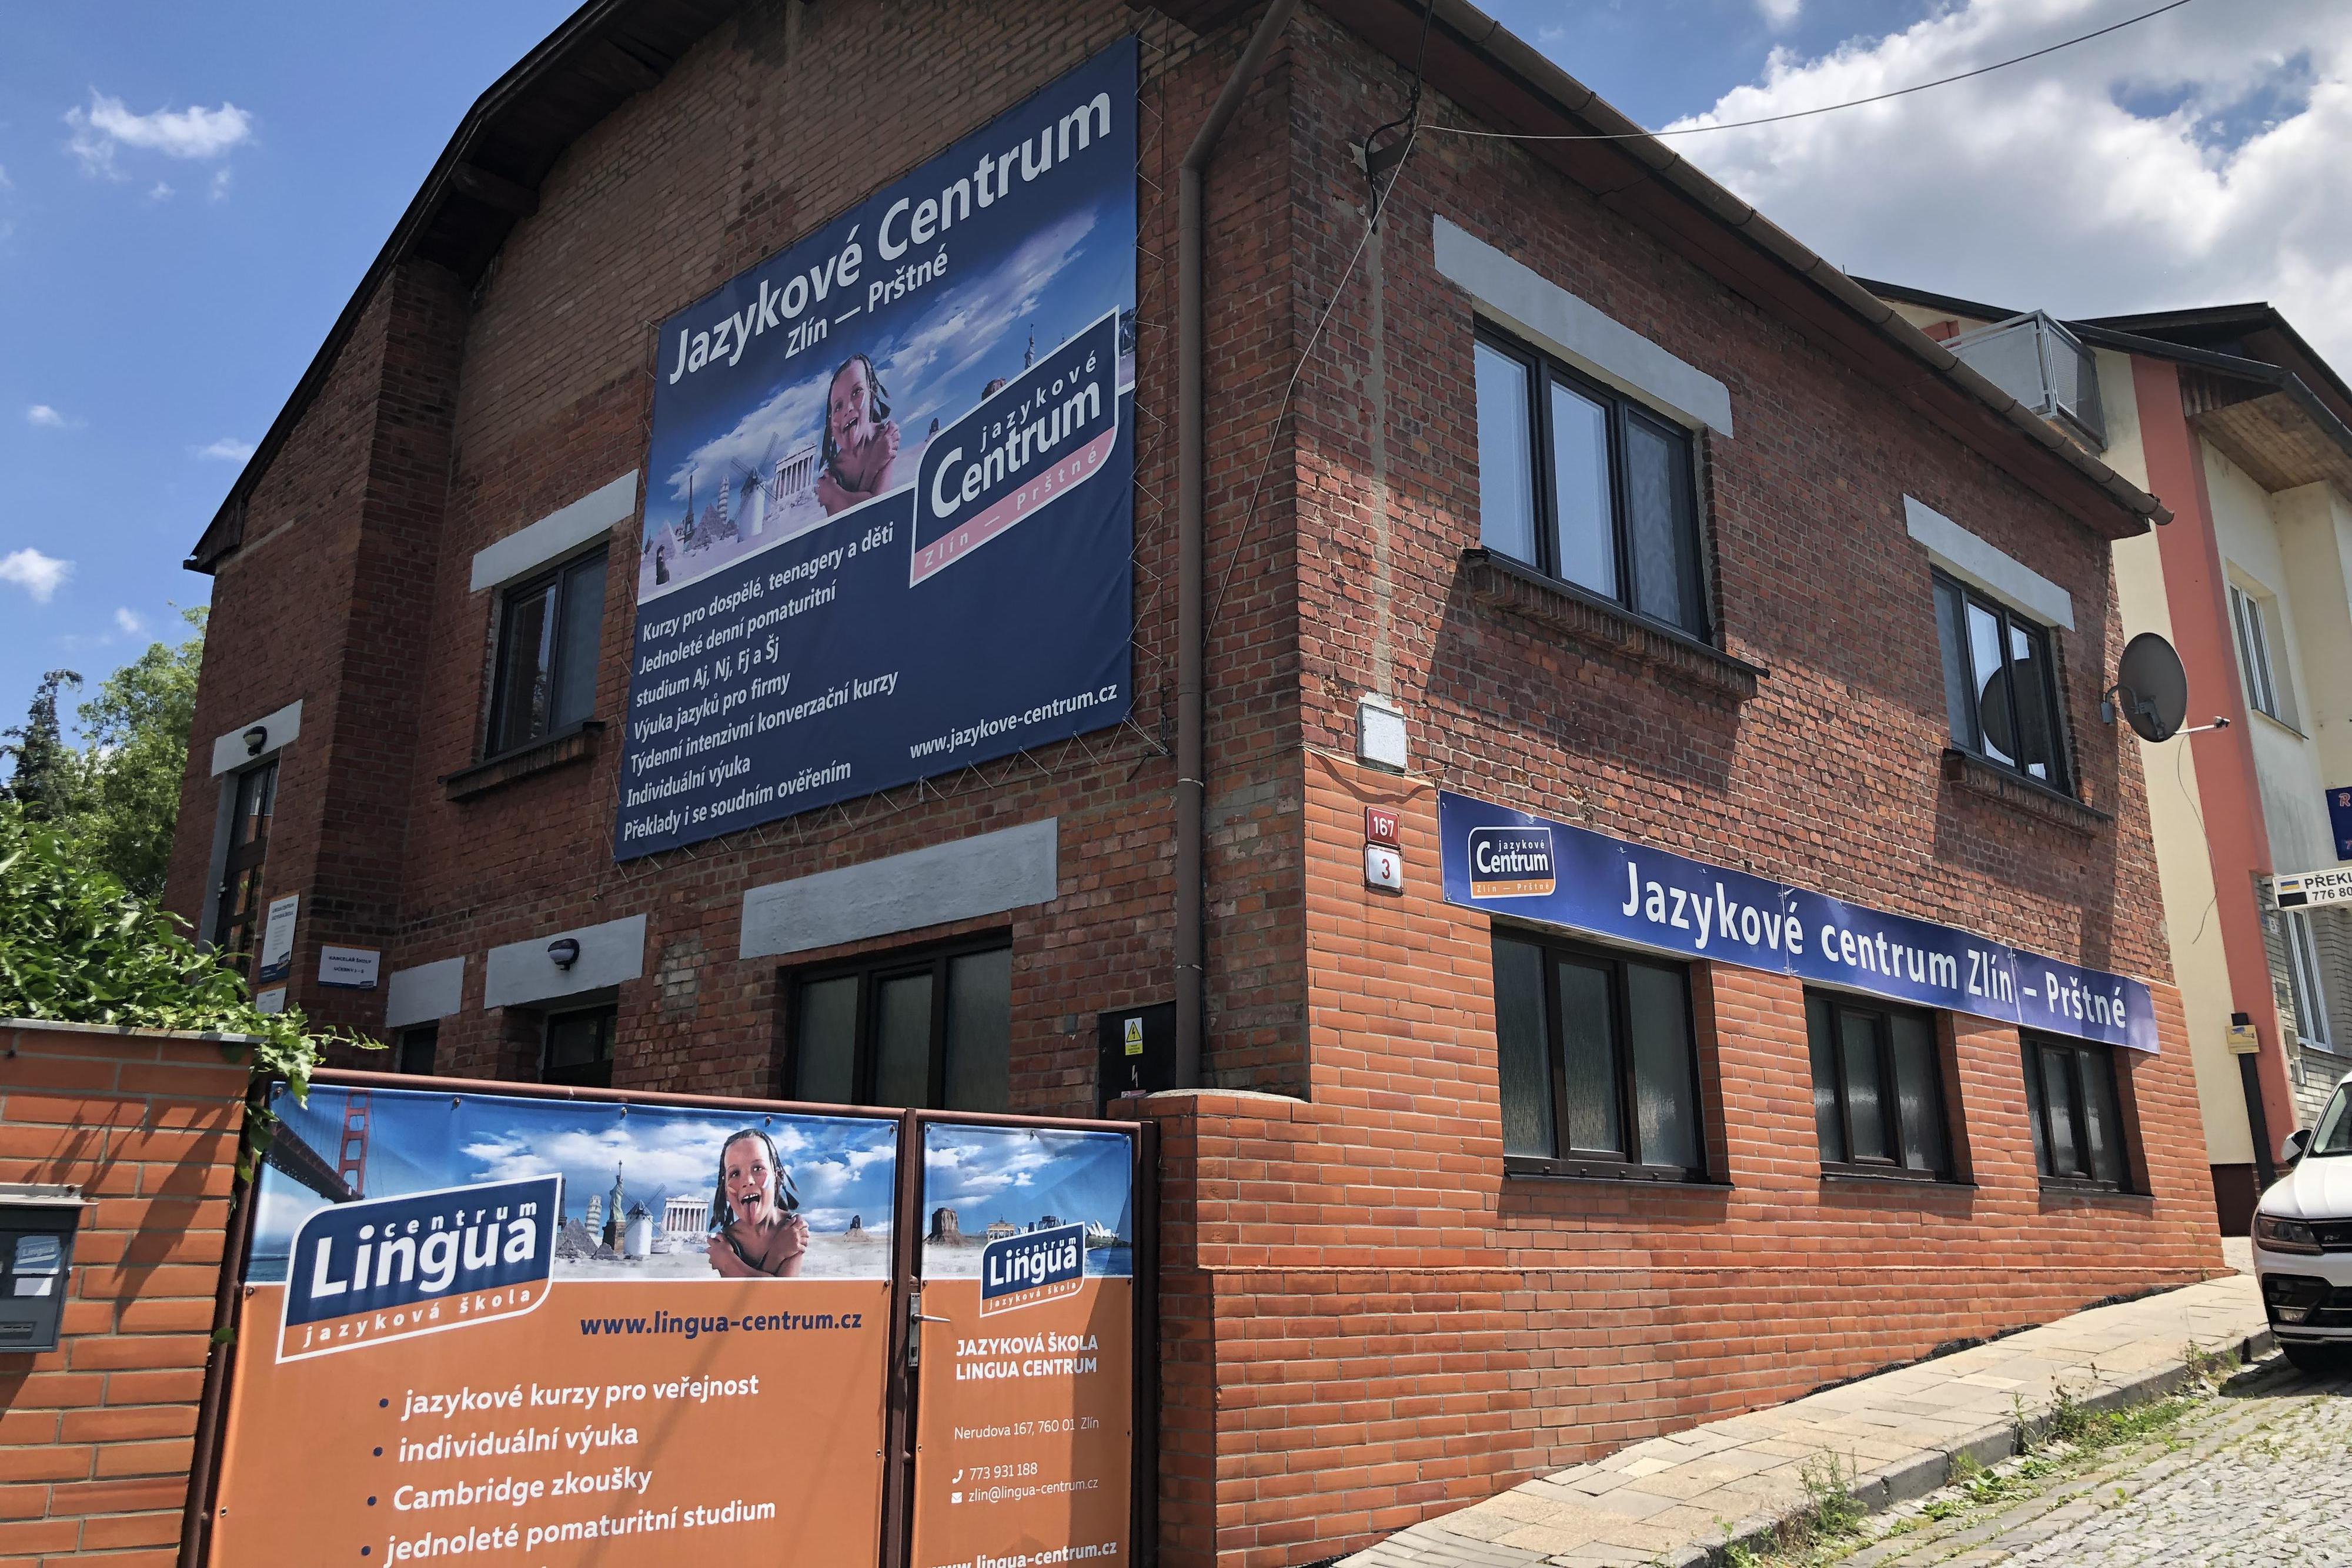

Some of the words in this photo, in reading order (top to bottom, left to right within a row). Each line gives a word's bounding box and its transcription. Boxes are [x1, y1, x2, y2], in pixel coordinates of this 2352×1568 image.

[669, 225, 863, 386] Jazykové
[877, 92, 1112, 260] Centrum
[784, 322, 827, 360] Zlín
[867, 244, 948, 315] Prštné
[980, 350, 1097, 453] jazykové
[931, 381, 1101, 518] Centrum
[924, 533, 968, 569] Zlín
[1017, 449, 1096, 511] Prštné
[643, 616, 680, 642] Kurzy
[682, 606, 706, 634] pro
[709, 577, 764, 617] dospělé,
[769, 546, 844, 591] teenagery
[847, 543, 857, 558] a
[861, 521, 894, 553] děti
[639, 634, 703, 675] Jednoleté
[706, 616, 744, 650] denní
[747, 579, 837, 639] pomaturitní
[636, 676, 689, 707] studium
[693, 666, 710, 692] Aj,
[714, 656, 733, 681] Nj,
[737, 647, 750, 674] Fj
[753, 649, 761, 665] a
[766, 634, 780, 664] Šj
[631, 740, 683, 778] Týdenní
[686, 715, 754, 757] intenzivní
[757, 681, 849, 732] konverzační
[853, 671, 899, 701] kurzy
[634, 713, 673, 744] Výuka
[675, 693, 719, 732] jazyků
[722, 689, 747, 716] pro
[751, 672, 791, 700] firmy
[910, 683, 1117, 759] www.jazykove-centrum.cz
[623, 808, 681, 842] Překlady
[684, 805, 690, 826] i
[692, 805, 707, 821] se
[710, 784, 774, 819] soudním
[777, 760, 852, 799] ověřením
[626, 765, 706, 808] Individuální
[709, 755, 751, 788] výuka
[1373, 815, 1394, 838] 167
[1498, 838, 1545, 852] jazykové
[1381, 858, 1391, 880] 3
[1476, 841, 1549, 874] Centrum
[1476, 884, 1496, 894] Zlín
[1517, 881, 1549, 892] Prštné
[2312, 890, 2335, 901] 776
[1622, 861, 1805, 955] Jazykové
[1821, 924, 1958, 991] centrum
[1968, 950, 2014, 1004] Zlín
[2047, 971, 2127, 1029] Prštné
[384, 1199, 538, 1239] centrum
[310, 1213, 537, 1299] Lingua
[990, 1243, 1077, 1288] Lingua
[1015, 1236, 1077, 1256] centrum
[303, 1301, 440, 1349] jazyková
[459, 1288, 530, 1314] škola
[988, 1289, 1041, 1310] jazyková
[1047, 1282, 1077, 1295] škola
[580, 1310, 861, 1339] www.lingua-centrum.cz
[956, 1331, 1045, 1357] JAZYKOVÁ
[1048, 1330, 1099, 1352] ŠKOLA
[956, 1360, 1020, 1380] LINGUA
[1023, 1357, 1097, 1377] CENTRUM
[400, 1383, 523, 1422] jazykové
[530, 1382, 600, 1409] kurzy
[605, 1382, 646, 1407] pro
[653, 1374, 759, 1403] veřejnost
[398, 1426, 560, 1463] individuální
[565, 1423, 638, 1455] výuka
[954, 1423, 1011, 1440] Nerudova
[1014, 1422, 1034, 1436] 167,
[1038, 1420, 1059, 1434] 760
[1062, 1419, 1075, 1432] 01
[1080, 1416, 1100, 1430] Zlín
[394, 1477, 543, 1511] Cambridge
[551, 1466, 652, 1496] zkoušky
[968, 1477, 1098, 1504] zlin@lingua-centrum.cz
[969, 1466, 991, 1482] 773
[994, 1464, 1014, 1479] 931
[1017, 1462, 1038, 1476] 188
[383, 1523, 519, 1568] jednoleté
[526, 1506, 678, 1551] pomaturitní
[682, 1498, 776, 1529] studium
